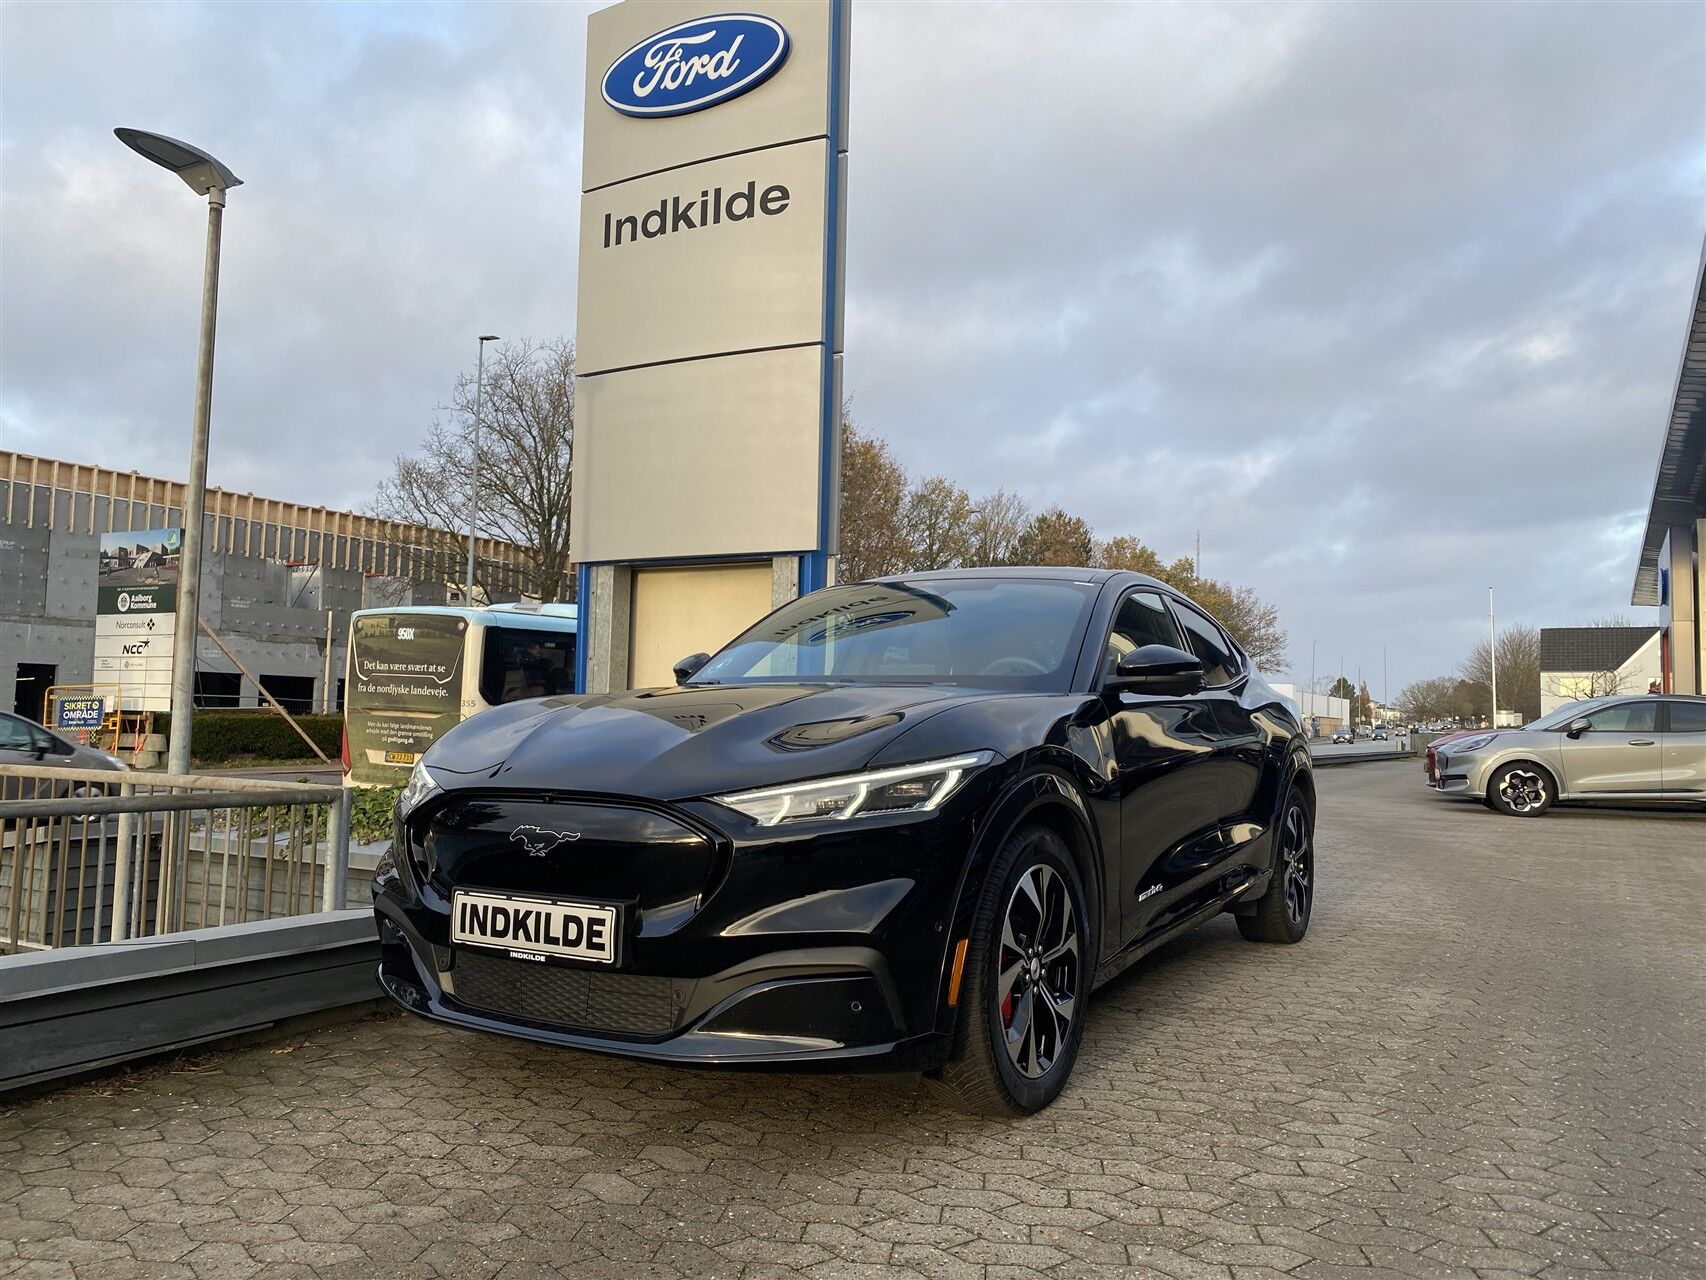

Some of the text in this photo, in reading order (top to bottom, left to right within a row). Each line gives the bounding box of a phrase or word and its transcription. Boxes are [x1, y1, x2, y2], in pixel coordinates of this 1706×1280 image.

[632, 29, 745, 98] Ford
[603, 180, 790, 249] Indkilde
[131, 594, 153, 603] Aalborg
[115, 620, 146, 629] Norconsult
[397, 627, 415, 640] 950X
[122, 645, 144, 654] NCC
[363, 660, 446, 673] Det kan være svært at se
[357, 682, 449, 698] fra de nordjyske landeveje.
[63, 701, 92, 710] SIKRET
[63, 709, 99, 719] OMRÅDE
[459, 902, 606, 951] INDKILDE
[509, 951, 546, 962] INDKILDE
